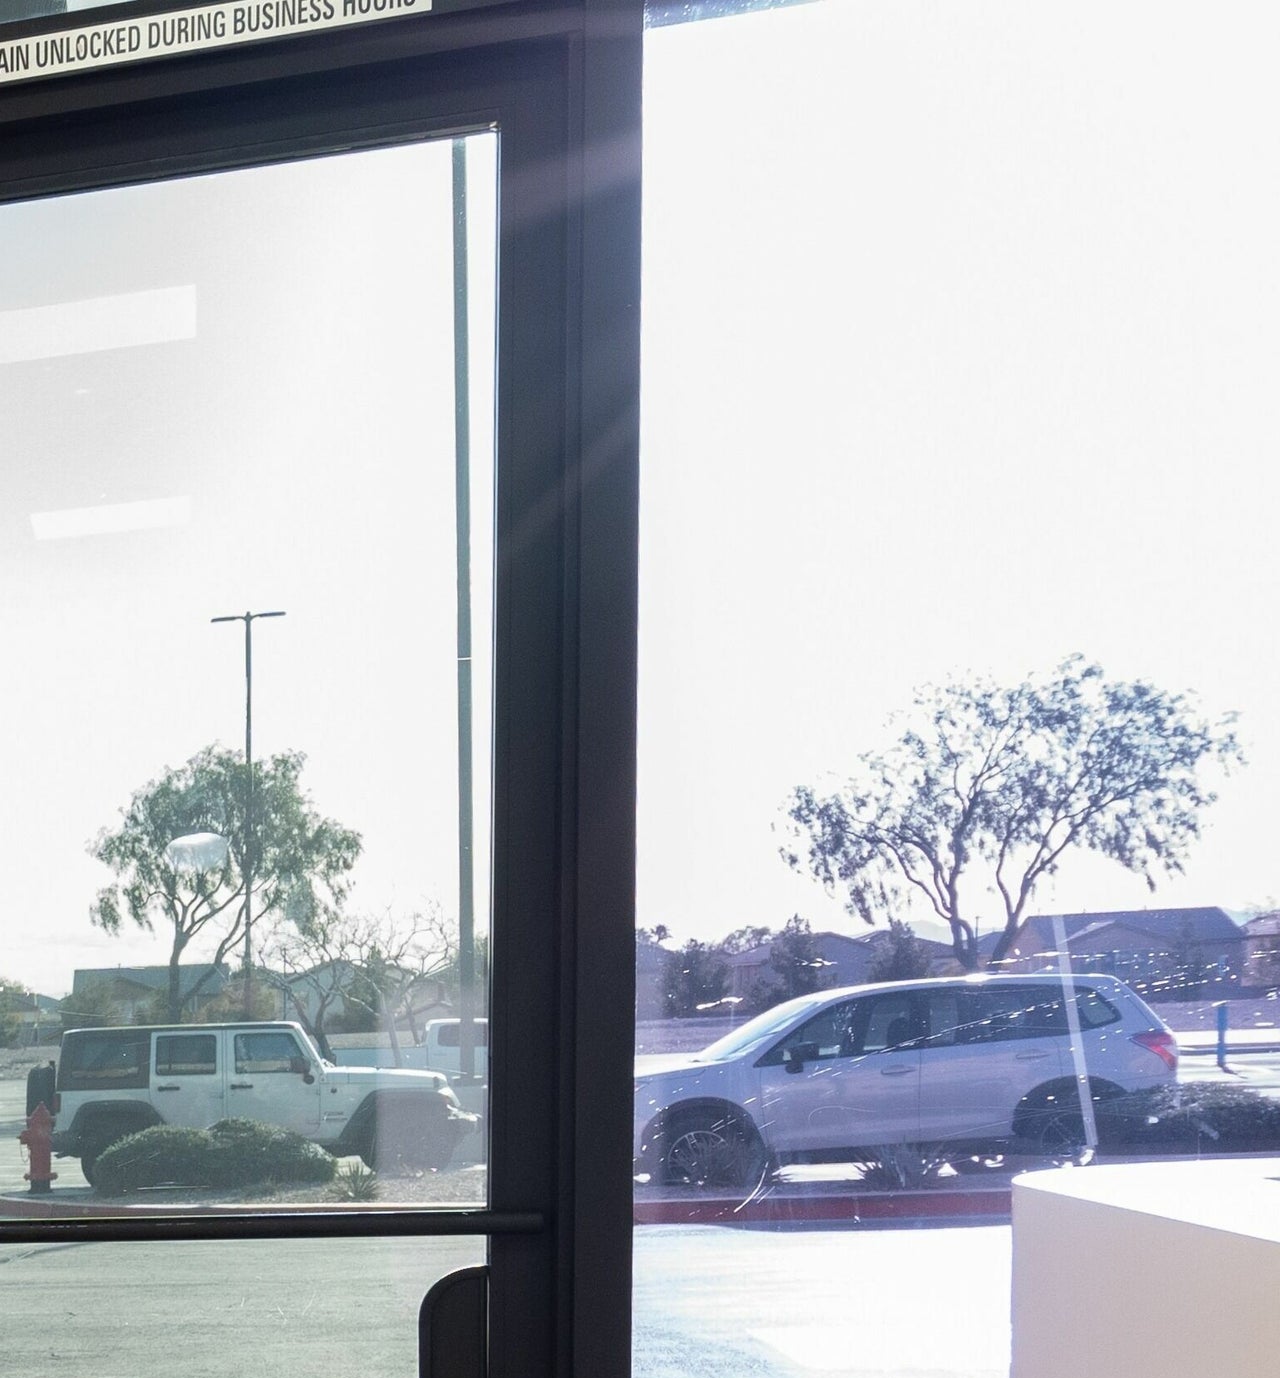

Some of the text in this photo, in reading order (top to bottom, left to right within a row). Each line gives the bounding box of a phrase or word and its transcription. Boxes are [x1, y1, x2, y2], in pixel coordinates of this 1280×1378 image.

[36, 24, 140, 68] UNLOCKED
[148, 10, 226, 49] DURING
[233, 0, 335, 35] BUSINESS
